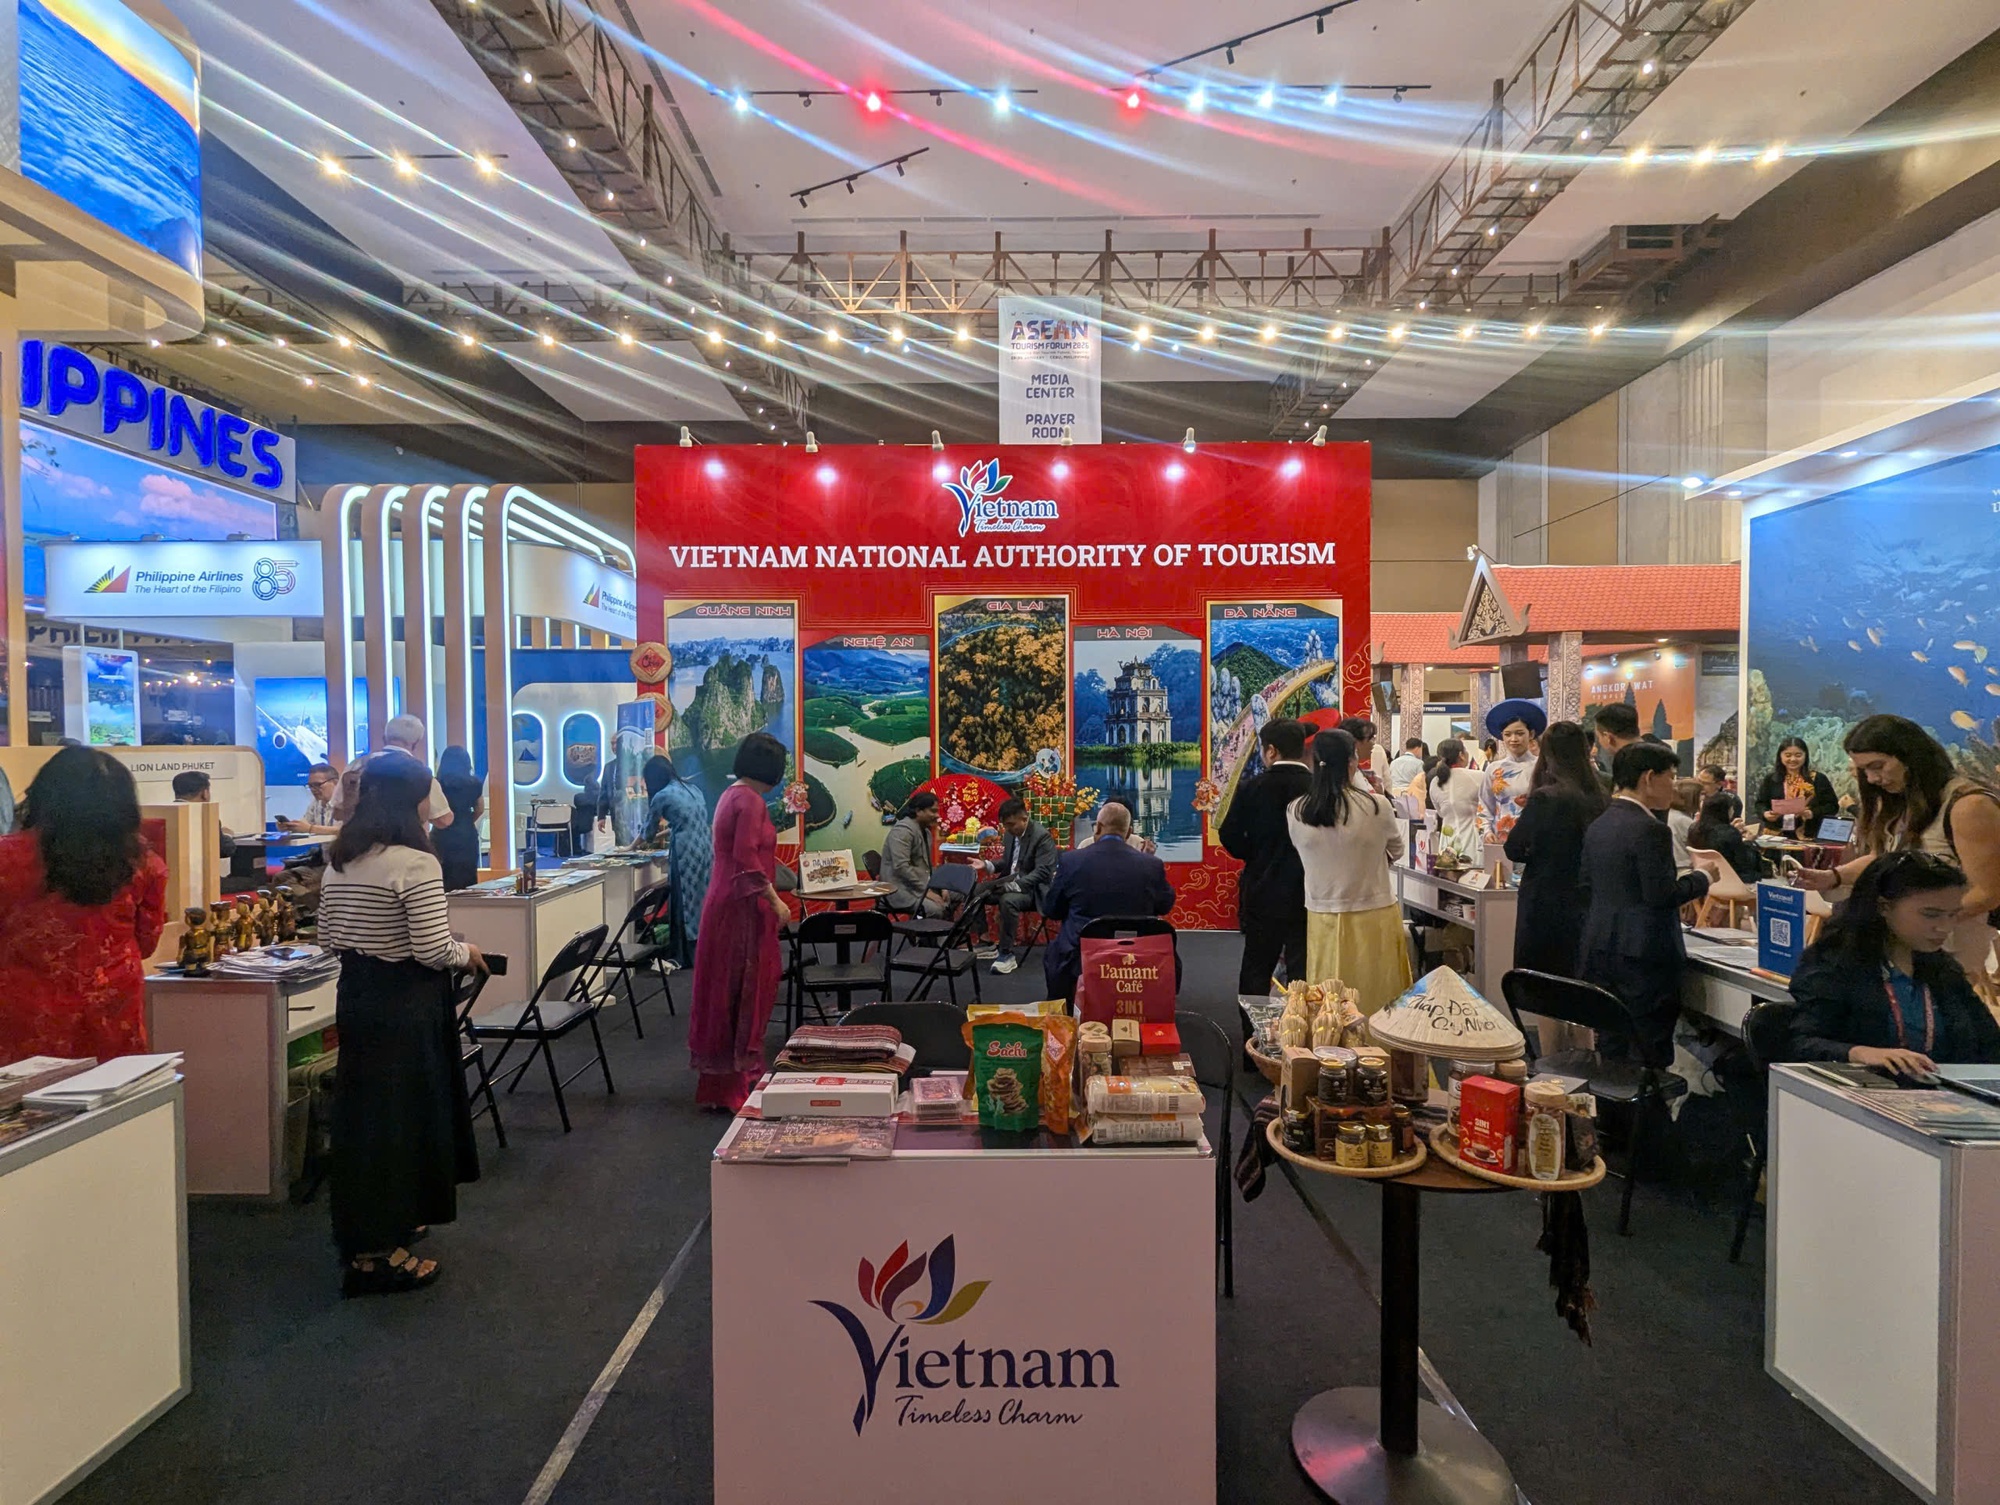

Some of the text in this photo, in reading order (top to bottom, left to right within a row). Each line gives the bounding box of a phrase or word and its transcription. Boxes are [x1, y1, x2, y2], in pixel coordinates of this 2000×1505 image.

[1011, 319, 1089, 340] ASEAN
[1011, 342, 1045, 350] TOURISM
[1045, 342, 1072, 350] FORUM
[1031, 374, 1070, 386] MEDIA
[1026, 387, 1075, 399] CENTER
[1026, 413, 1076, 425] PRAYER
[942, 483, 1059, 537] Vietnam
[974, 518, 1044, 533] Timeless Charm
[669, 542, 1337, 568] VIETNAM NATIONAL AUTHORITY OF TOURISM
[136, 571, 195, 584] Philippine
[198, 571, 244, 581] Airlines
[135, 584, 241, 595] The Heart of the Filipino
[696, 602, 792, 617] QUẢNG NINH
[987, 600, 1044, 611] GIA LAI
[1097, 627, 1152, 640] HÀ NỘI
[843, 636, 914, 649] NGHỆ AN
[1591, 680, 1653, 693] ANGKOR WAT
[131, 761, 215, 772] LION LAND PHUKET
[1100, 963, 1159, 980] L'amant
[1116, 980, 1143, 993] Café
[806, 1299, 1121, 1437] Vietnam
[895, 1394, 1083, 1427] Timeless Charm
